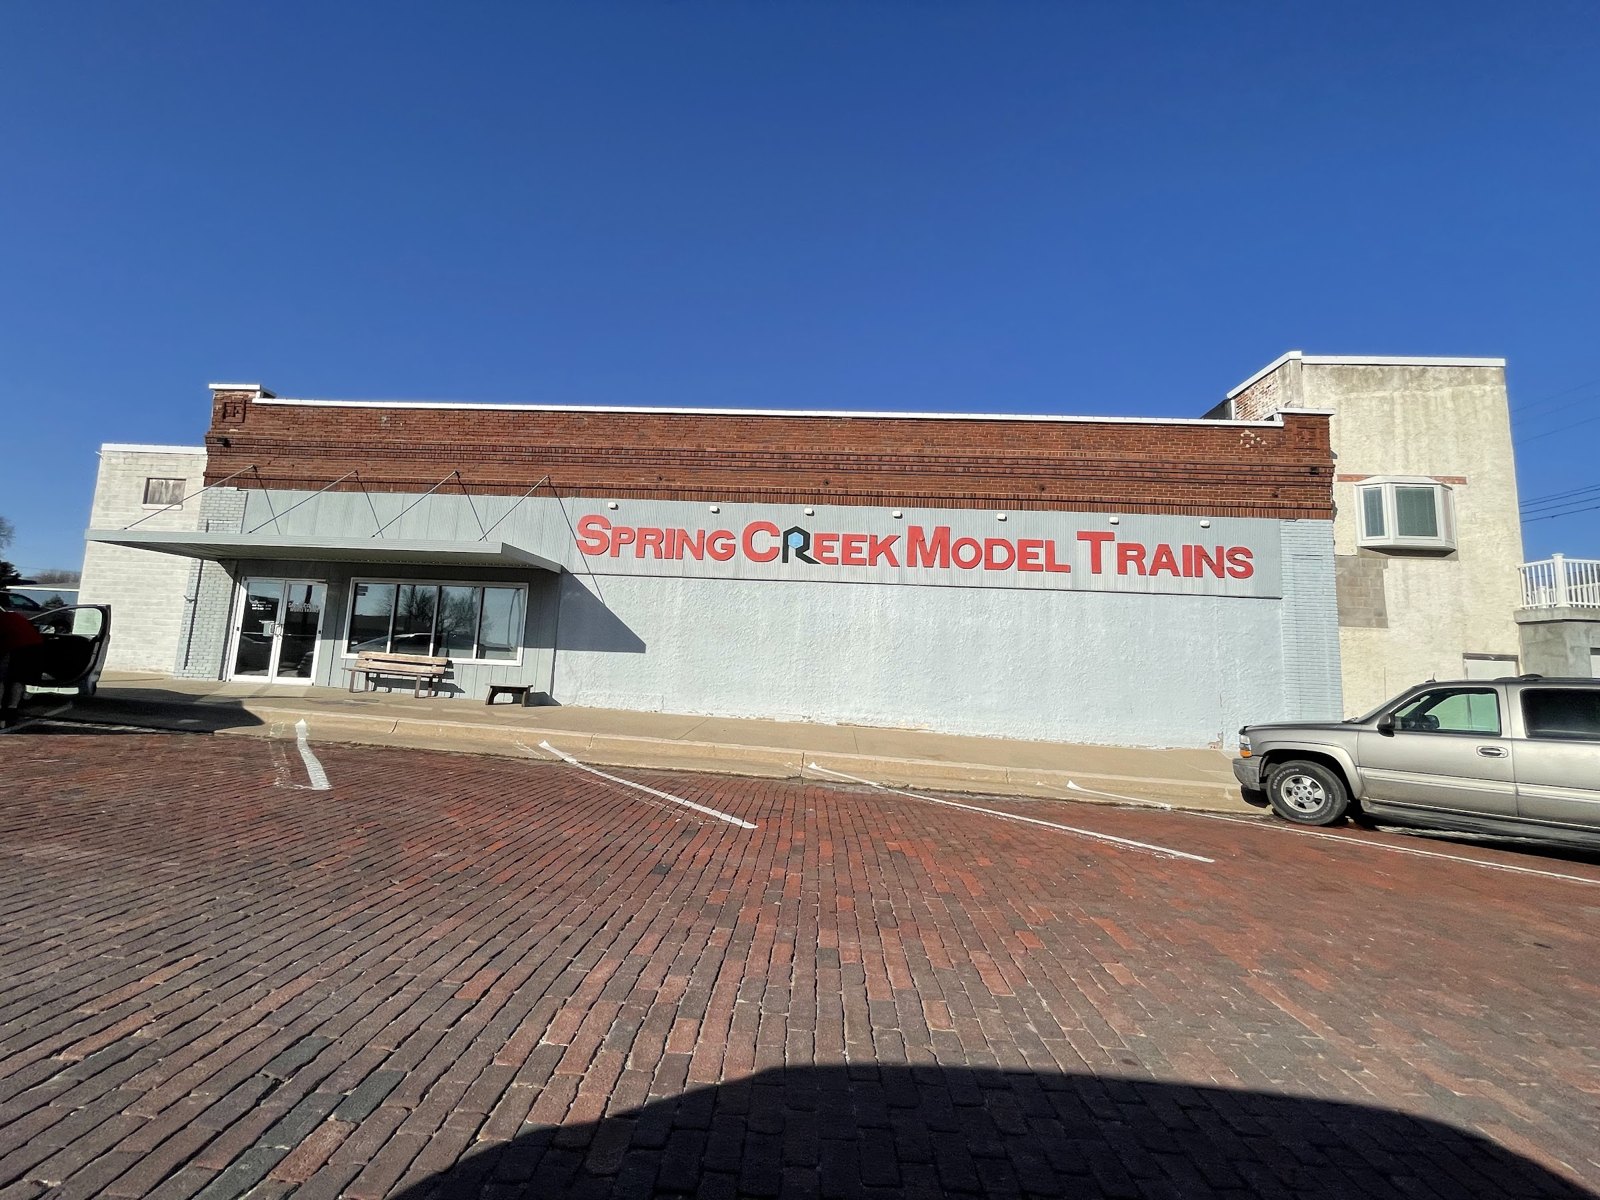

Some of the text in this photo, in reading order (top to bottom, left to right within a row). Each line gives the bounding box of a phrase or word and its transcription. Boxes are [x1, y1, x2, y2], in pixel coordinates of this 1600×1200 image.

[576, 514, 1254, 579] SPRING CREEK MODEL TRAINS
